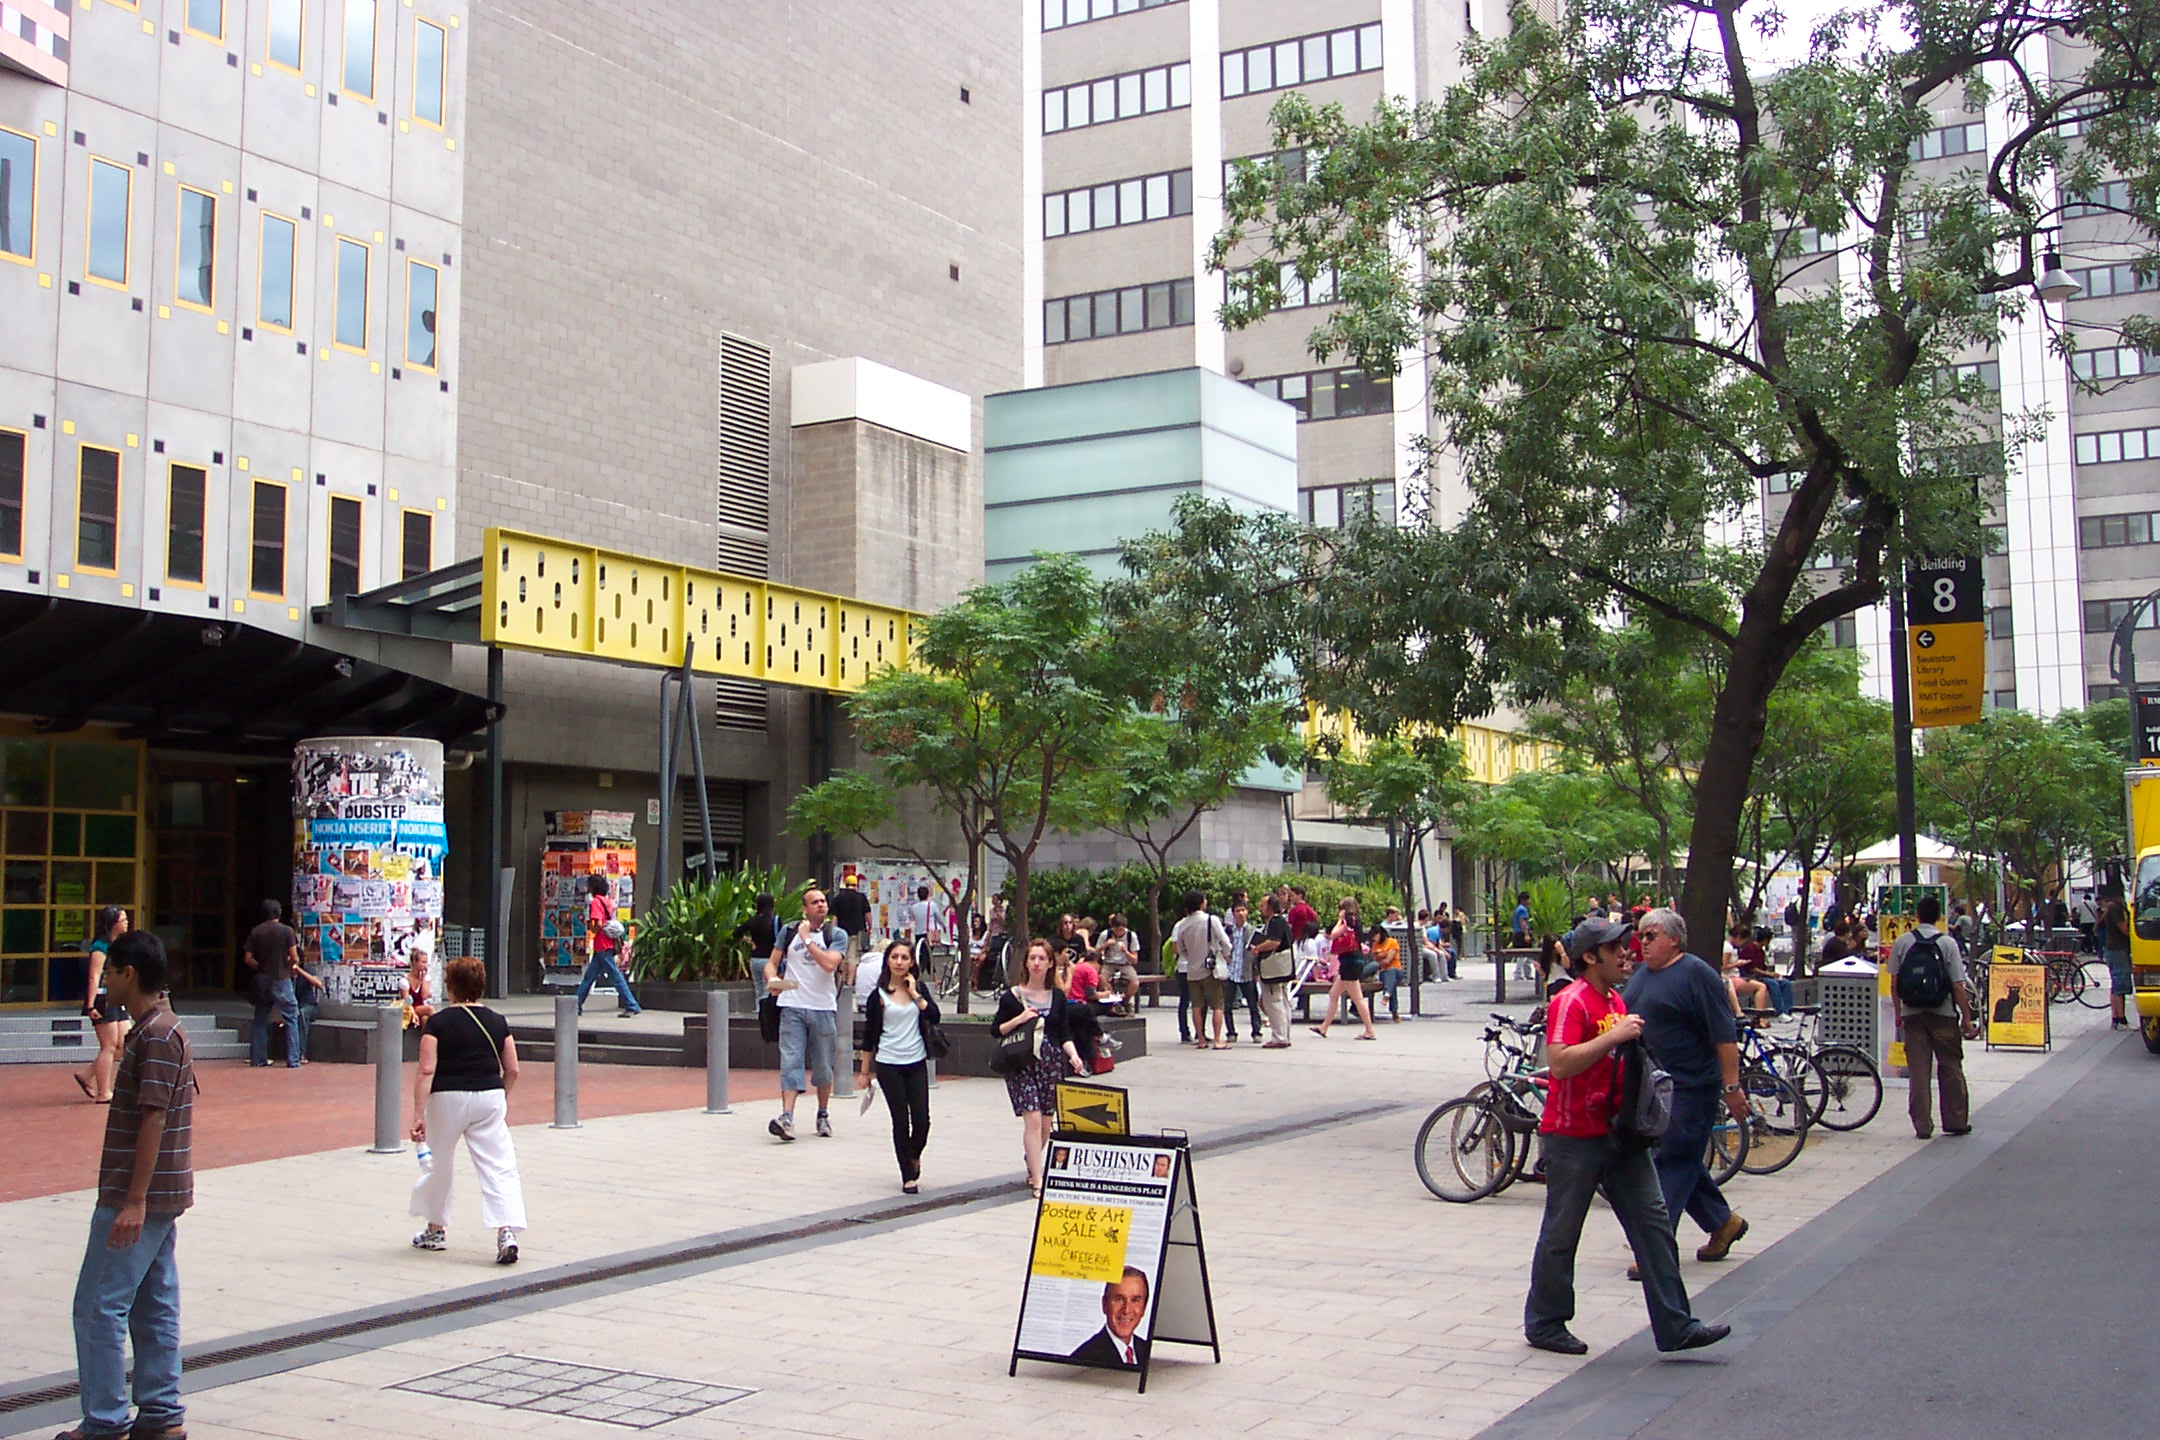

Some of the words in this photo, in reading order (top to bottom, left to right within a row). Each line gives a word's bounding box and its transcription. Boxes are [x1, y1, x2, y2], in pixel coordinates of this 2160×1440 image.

[1921, 557, 1966, 571] Building
[1933, 577, 1957, 614] 8
[1917, 655, 1956, 664] Swanston
[1917, 666, 1945, 676] Library
[1918, 678, 1938, 687] Food
[1939, 678, 1968, 687] Outlets
[1941, 692, 1964, 700] Union
[1920, 706, 1950, 715] Student
[2147, 736, 2160, 752] 1
[349, 772, 379, 796] THE
[345, 804, 406, 819] DUBSTEP
[315, 823, 347, 835] NOKIA
[2020, 997, 2042, 1009] NOIR
[1073, 1148, 1151, 1171] BUSHISMS
[1054, 1179, 1075, 1188] THINK
[1075, 1181, 1089, 1189] WAR
[1089, 1182, 1096, 1190] IS
[1102, 1183, 1142, 1193] DANGEROUS
[1142, 1187, 1163, 1196] PLACE
[1058, 1192, 1080, 1200] FUTURE
[1105, 1196, 1128, 1204] BETTER
[1129, 1198, 1164, 1207] TOMORROW
[1041, 1203, 1082, 1220] Poster
[1085, 1207, 1097, 1222] &
[1100, 1208, 1125, 1223] Art
[1061, 1222, 1098, 1238] SALE
[1043, 1236, 1072, 1248] MAIN
[1061, 1248, 1111, 1266] CAFETERIA
